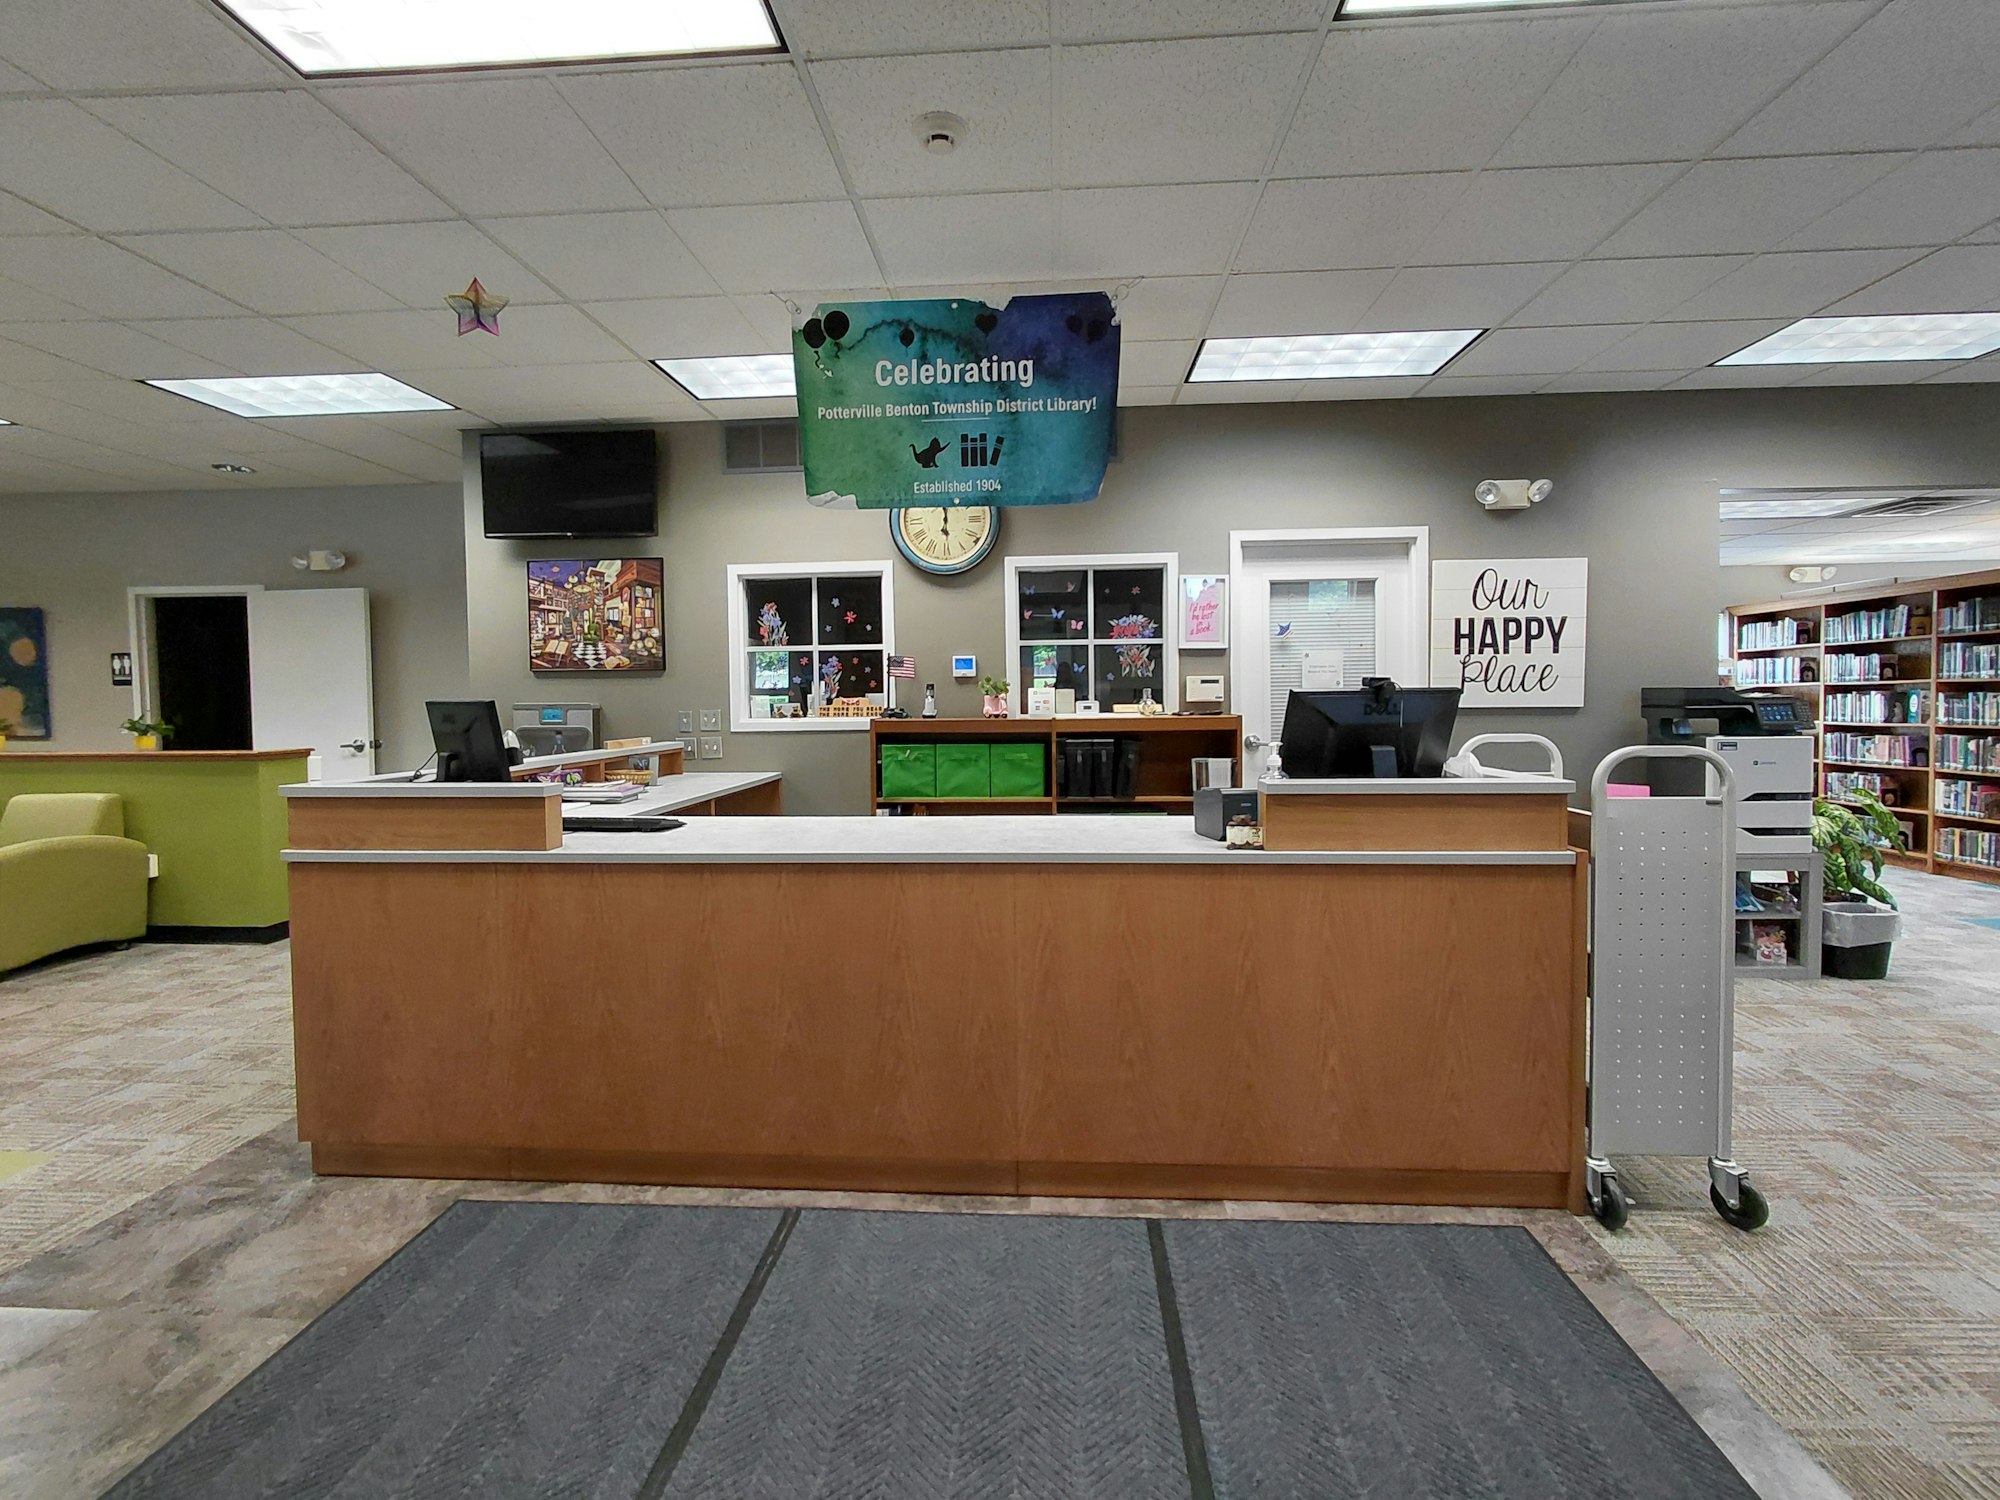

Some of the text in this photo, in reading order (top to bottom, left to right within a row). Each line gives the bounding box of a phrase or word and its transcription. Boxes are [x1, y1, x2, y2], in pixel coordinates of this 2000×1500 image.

[875, 355, 1034, 387] Celebrating
[817, 396, 1097, 420] Potterville Benton Township District Library!
[913, 479, 1002, 494] Established 1904
[1472, 568, 1549, 611] Our
[1454, 616, 1568, 655] HAPPY
